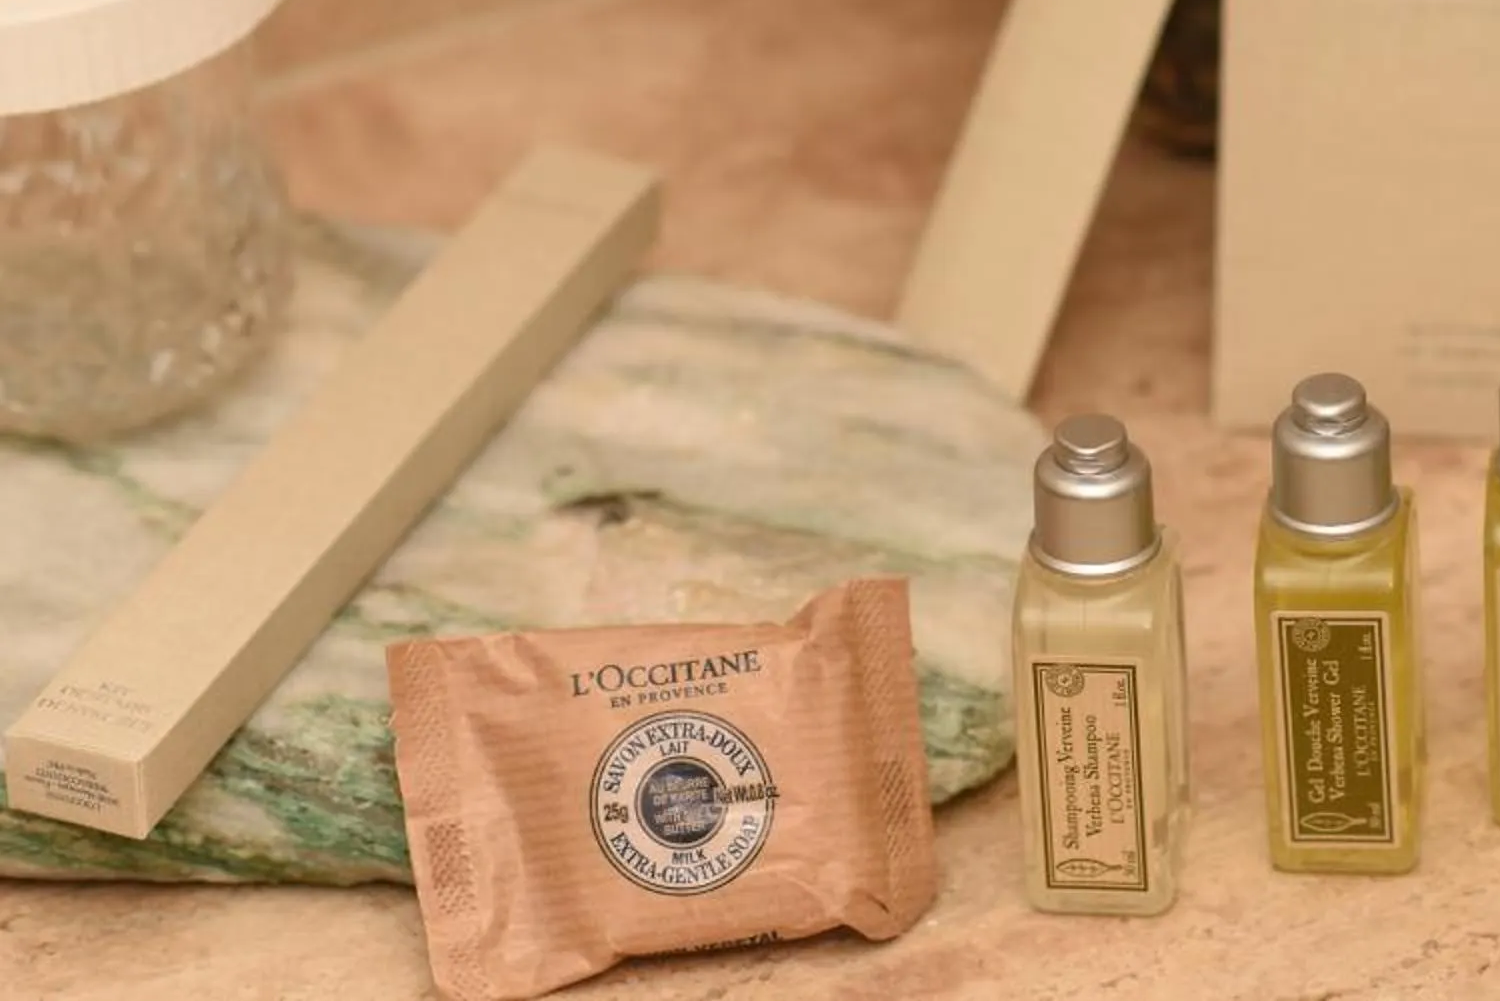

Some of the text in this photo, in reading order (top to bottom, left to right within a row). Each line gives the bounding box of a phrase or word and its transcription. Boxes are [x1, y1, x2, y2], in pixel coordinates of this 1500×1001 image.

[570, 648, 763, 698] L'OCCITANE
[610, 681, 729, 710] EN PROVENCE
[603, 721, 756, 795] SAVON EXTRA-DOUX
[658, 740, 690, 757] LAIT
[1303, 657, 1326, 804] Gel Douche Verveine
[1322, 659, 1346, 801] Verbena Shower Gel
[1056, 706, 1081, 851] Shampooing Verveine
[1082, 714, 1103, 839] Verbena Shampoo
[1105, 731, 1126, 825] L'OCCITANE
[603, 802, 629, 824] 25g
[610, 815, 761, 885] EXTRA-GENTLE SOAP
[671, 849, 706, 866] MILK
